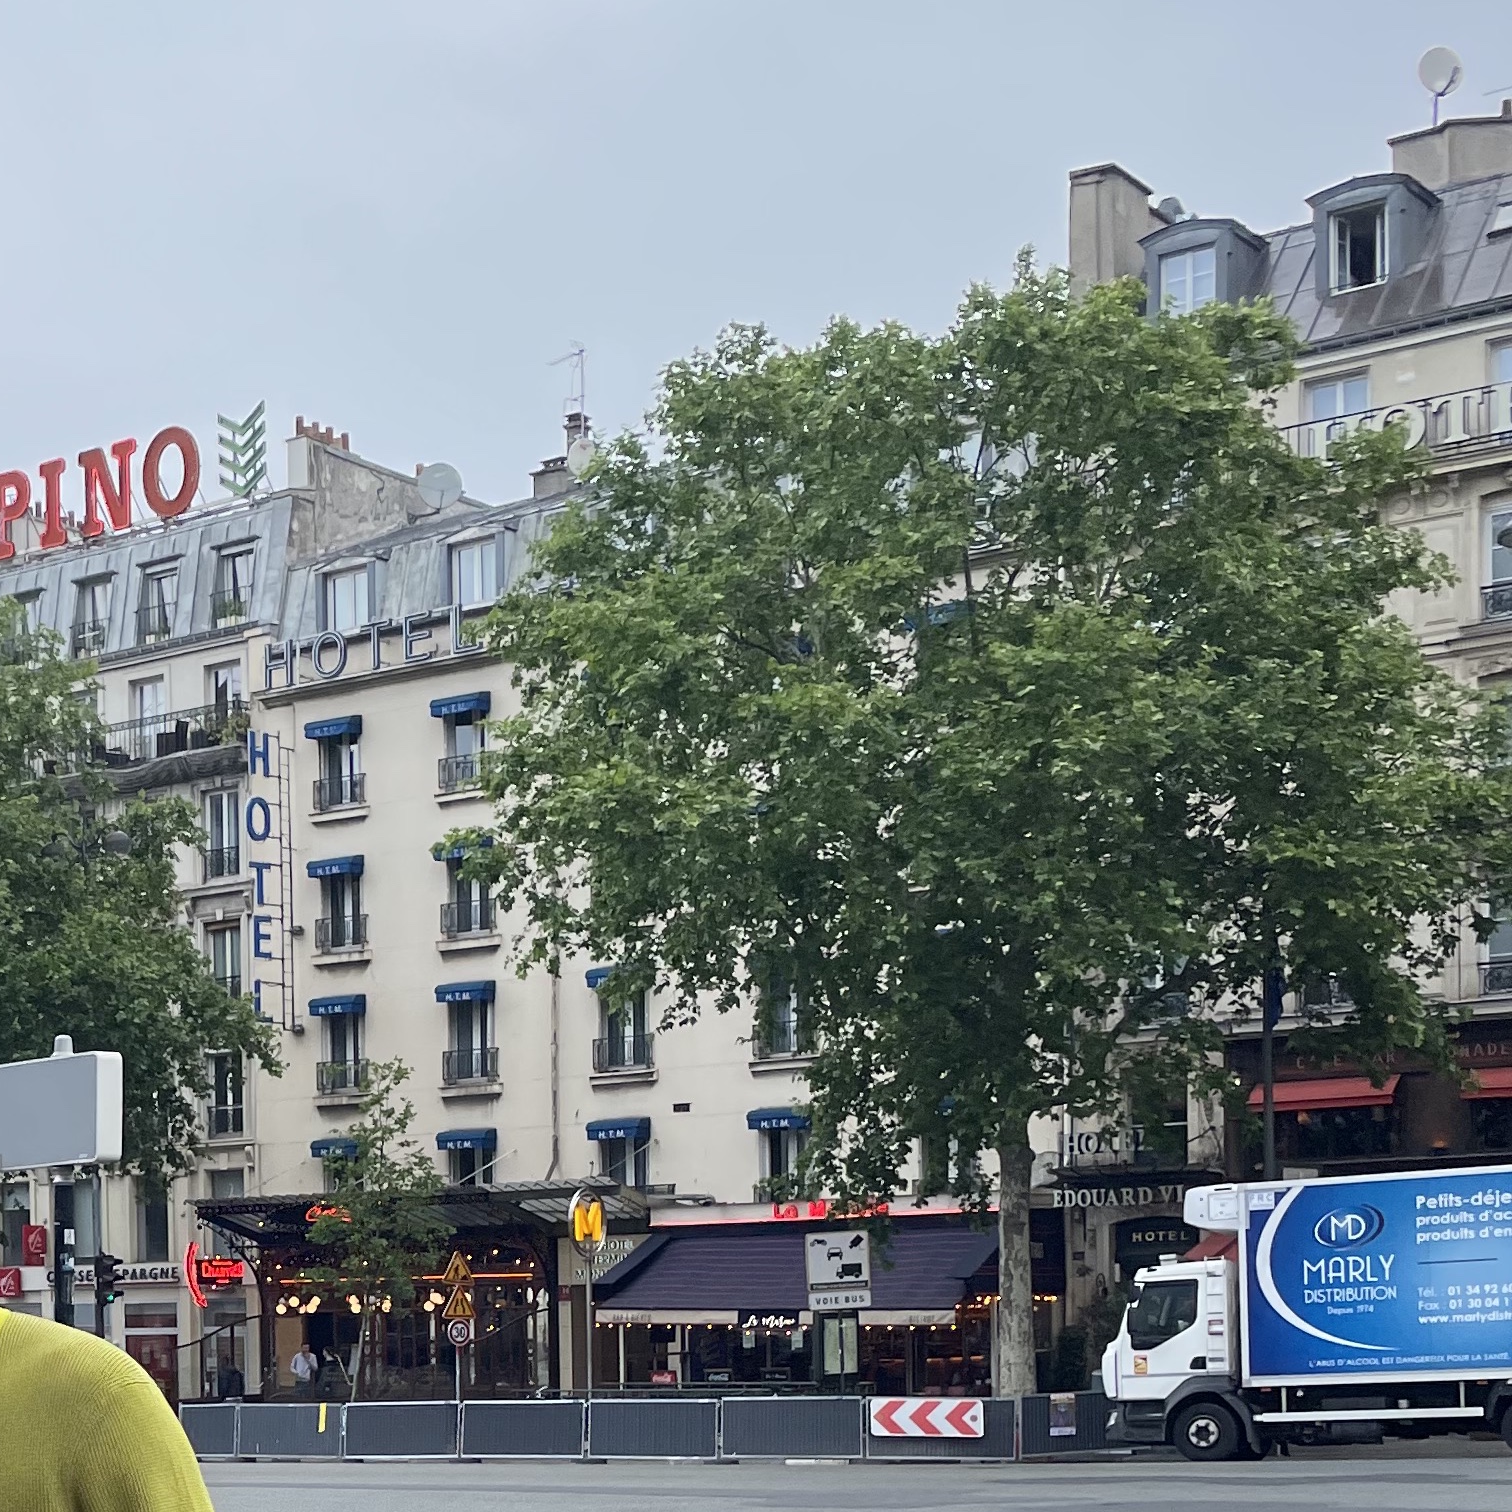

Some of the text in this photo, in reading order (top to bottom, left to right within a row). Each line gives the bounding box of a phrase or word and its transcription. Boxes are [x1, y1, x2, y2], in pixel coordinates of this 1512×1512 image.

[263, 603, 490, 690] HOTEL
[245, 730, 274, 1024] HOTEL
[574, 1201, 602, 1242] M
[1330, 1214, 1366, 1241] MD
[1416, 1212, 1475, 1229] produits
[1132, 1231, 1189, 1243] HOTEL
[1416, 1228, 1476, 1245] produits
[1303, 1254, 1395, 1286] MARLY
[1304, 1285, 1397, 1304] DISTRIBUTION
[1447, 1285, 1461, 1296] 01
[1465, 1284, 1481, 1296] 34
[1483, 1283, 1498, 1295] 92
[815, 1293, 866, 1306] VOIE BUS
[1449, 1299, 1463, 1310] 01
[1467, 1298, 1482, 1309] 30
[1485, 1297, 1500, 1308] 04
[453, 1326, 466, 1338] 30
